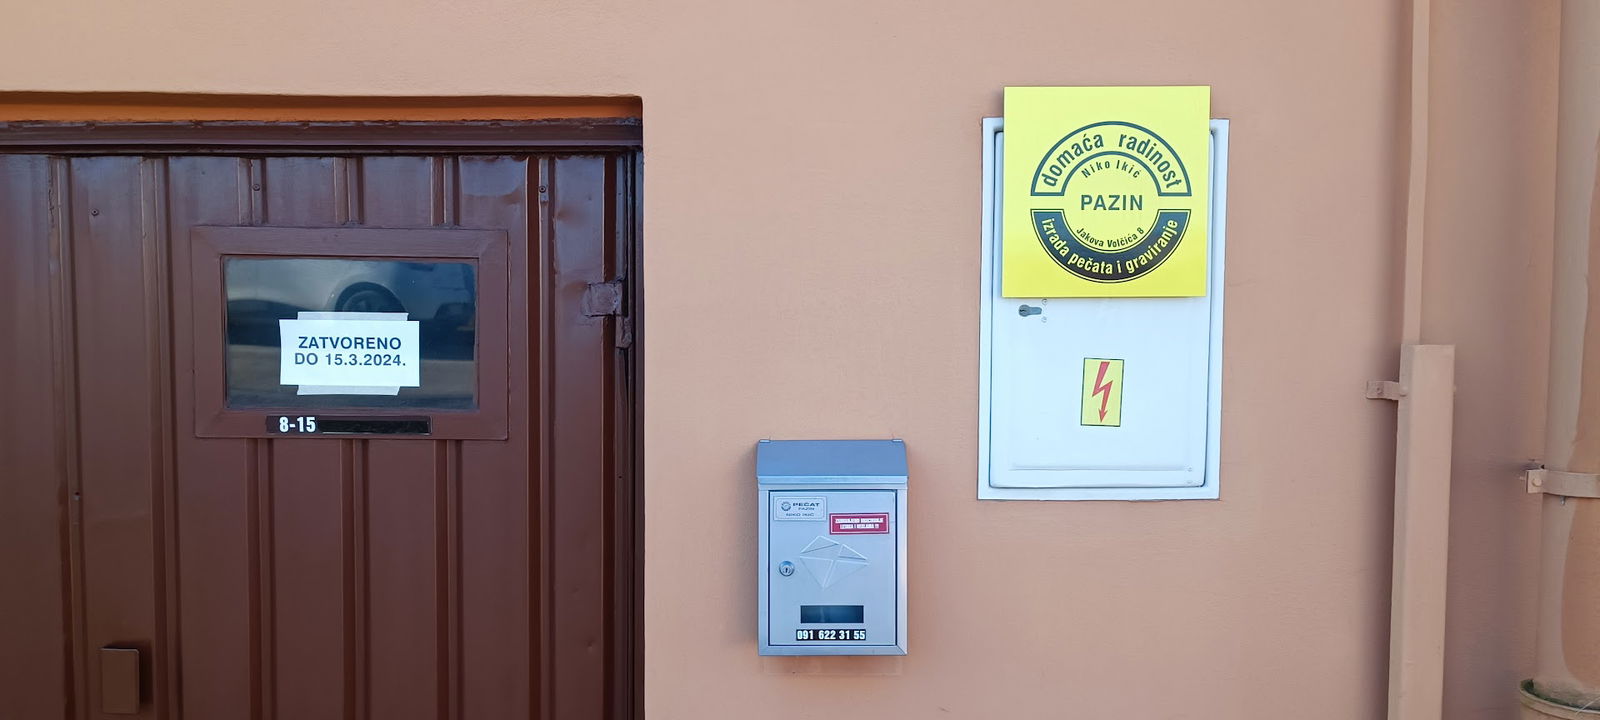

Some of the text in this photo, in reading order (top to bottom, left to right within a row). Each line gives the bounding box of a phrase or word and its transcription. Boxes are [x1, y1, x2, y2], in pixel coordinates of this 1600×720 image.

[1042, 134, 1182, 188] domaća radinost
[1081, 160, 1110, 178] Niko
[1080, 194, 1142, 210] PAZIN
[1042, 218, 1178, 274] izrada pečata i graviranje
[1076, 228, 1104, 247] Jakova
[1107, 233, 1138, 248] Volčića
[298, 336, 402, 350] ZATVORENO
[294, 353, 406, 366] DO 15.3.2024.
[279, 416, 316, 432] 8-15
[797, 630, 866, 640] 091 622 31 55
